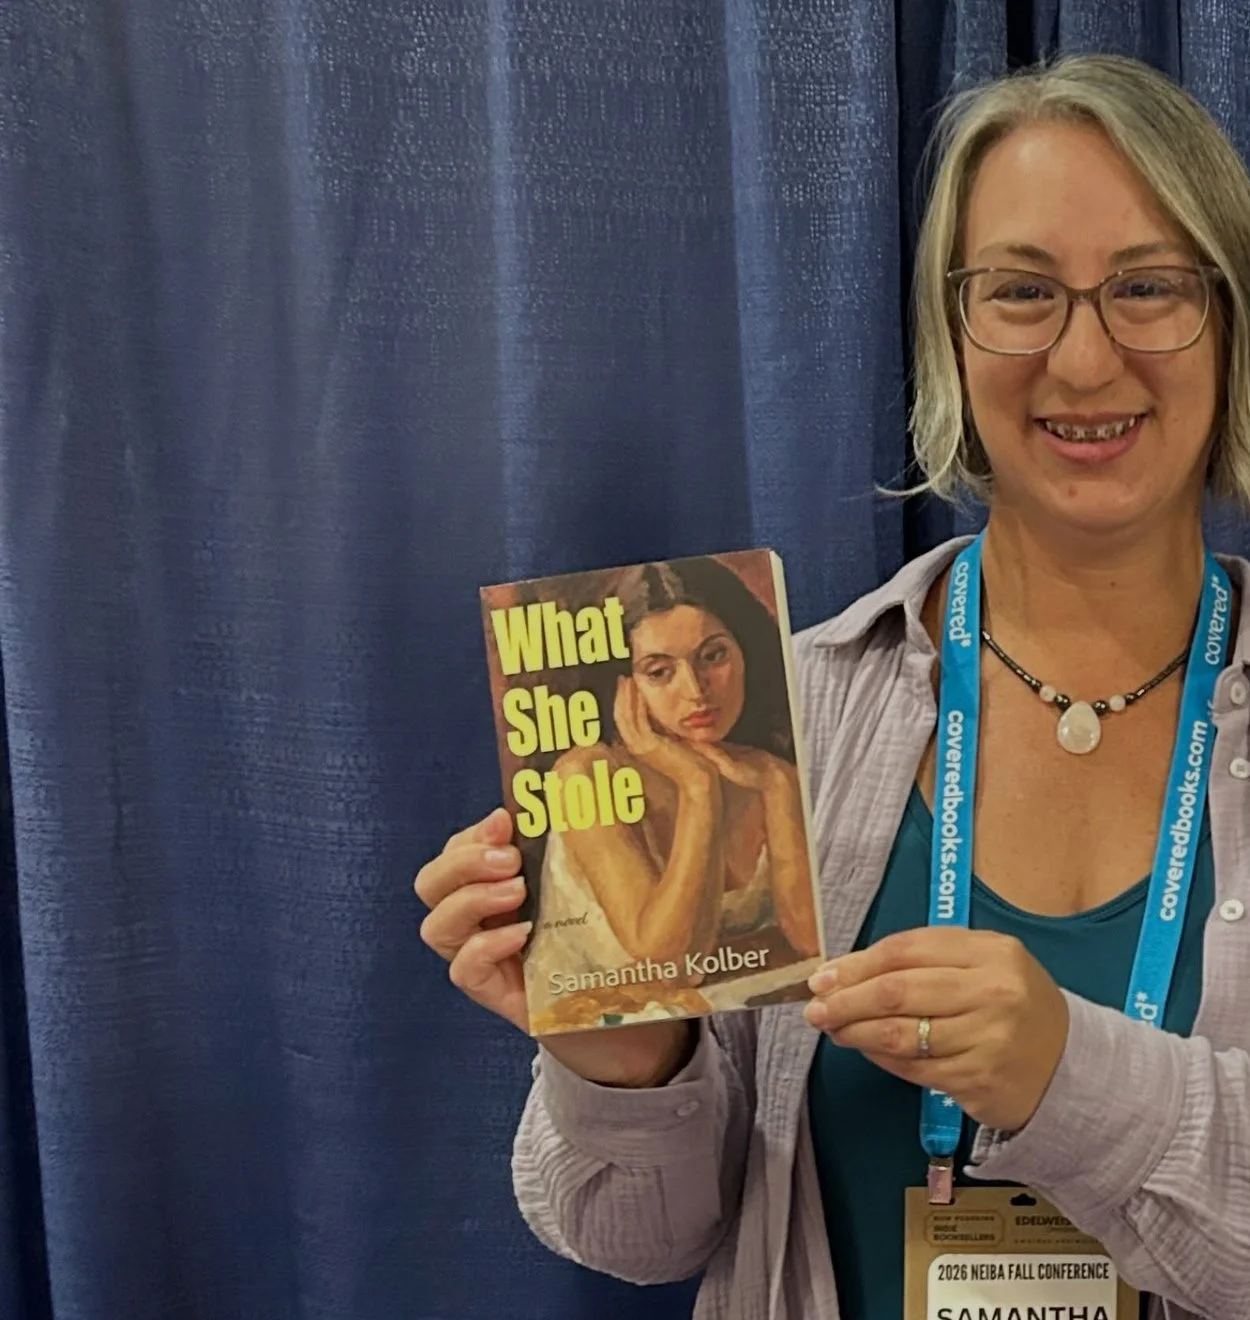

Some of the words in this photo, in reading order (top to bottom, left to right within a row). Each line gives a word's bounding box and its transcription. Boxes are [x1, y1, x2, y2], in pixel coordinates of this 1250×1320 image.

[491, 597, 630, 675] What
[503, 685, 600, 757] She
[512, 759, 645, 838] Stole
[937, 710, 964, 919] coveredbooks.com
[1160, 720, 1208, 921] coveredbooks.com
[548, 958, 678, 995] Samantha
[685, 947, 770, 976] Kolber
[938, 1264, 967, 1281] 2026
[971, 1264, 1005, 1280] NEIBA
[1008, 1264, 1035, 1280] FALL
[1038, 1263, 1109, 1280] CONFERENCE
